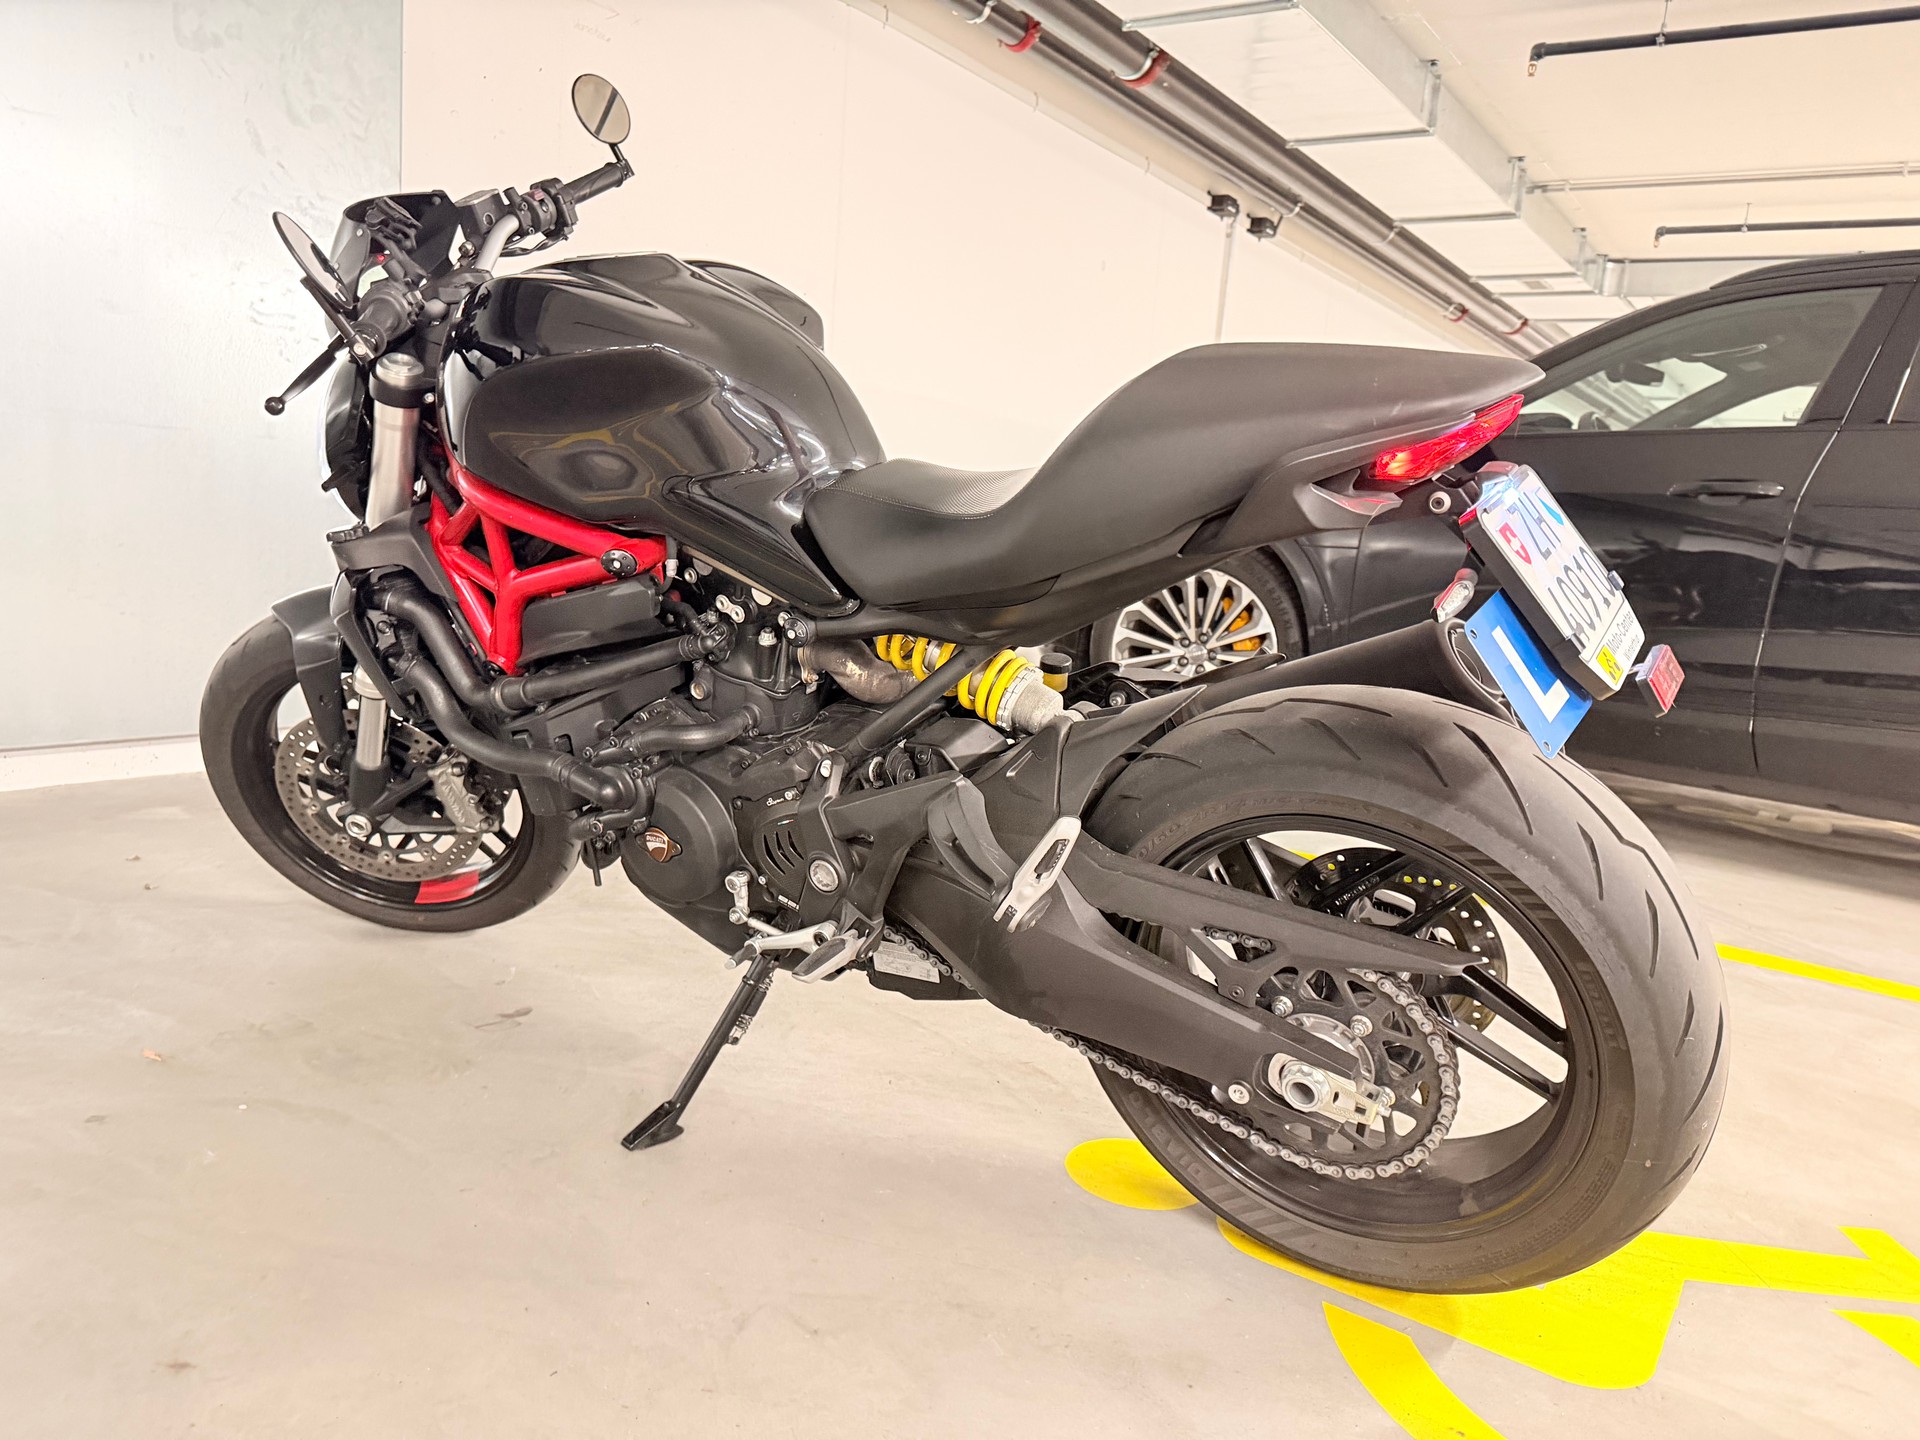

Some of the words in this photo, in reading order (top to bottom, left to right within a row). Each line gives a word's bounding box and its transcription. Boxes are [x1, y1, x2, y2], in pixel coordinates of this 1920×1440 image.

[1506, 490, 1561, 560] ZH
[1548, 546, 1615, 643] 40910
[1491, 626, 1570, 723] L
